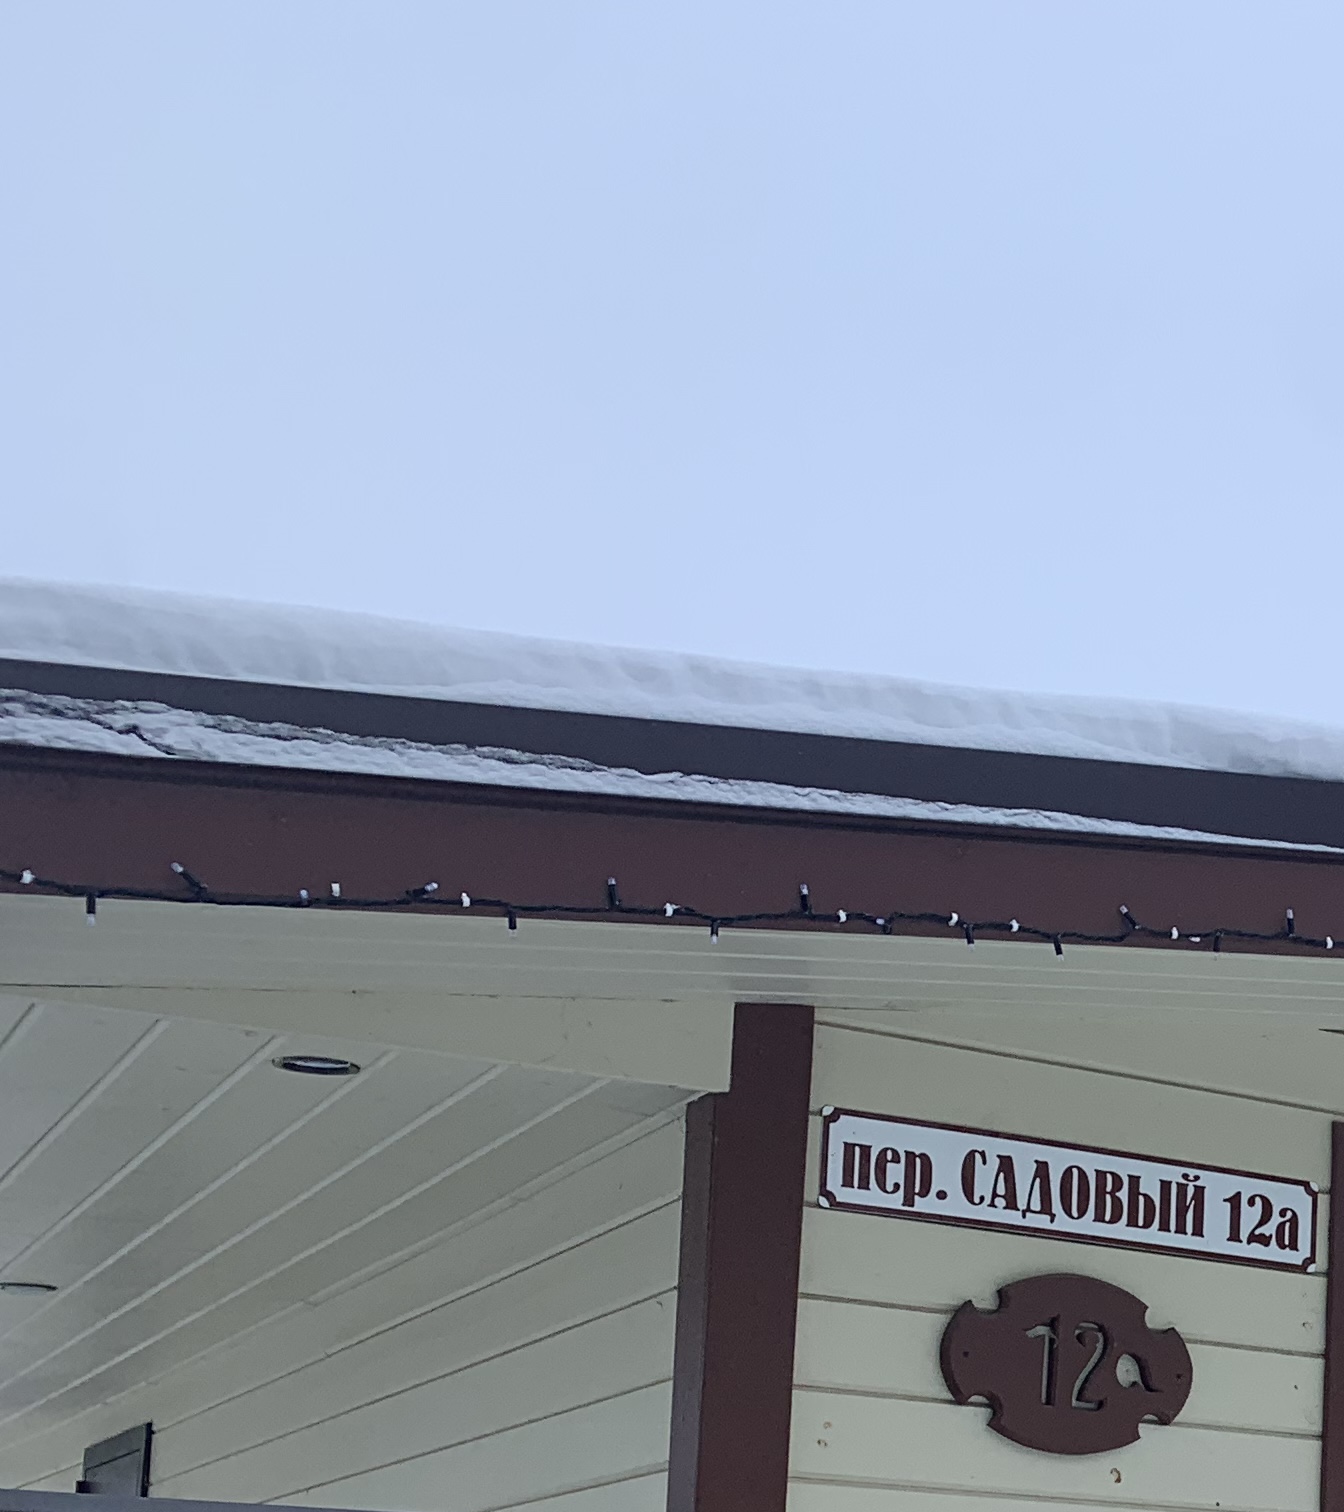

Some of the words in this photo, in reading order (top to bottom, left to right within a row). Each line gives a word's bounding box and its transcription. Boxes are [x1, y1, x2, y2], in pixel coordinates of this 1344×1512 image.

[840, 1141, 948, 1207] пер.
[960, 1149, 1207, 1239] САДОВЫЙ
[1222, 1190, 1300, 1252] 12а
